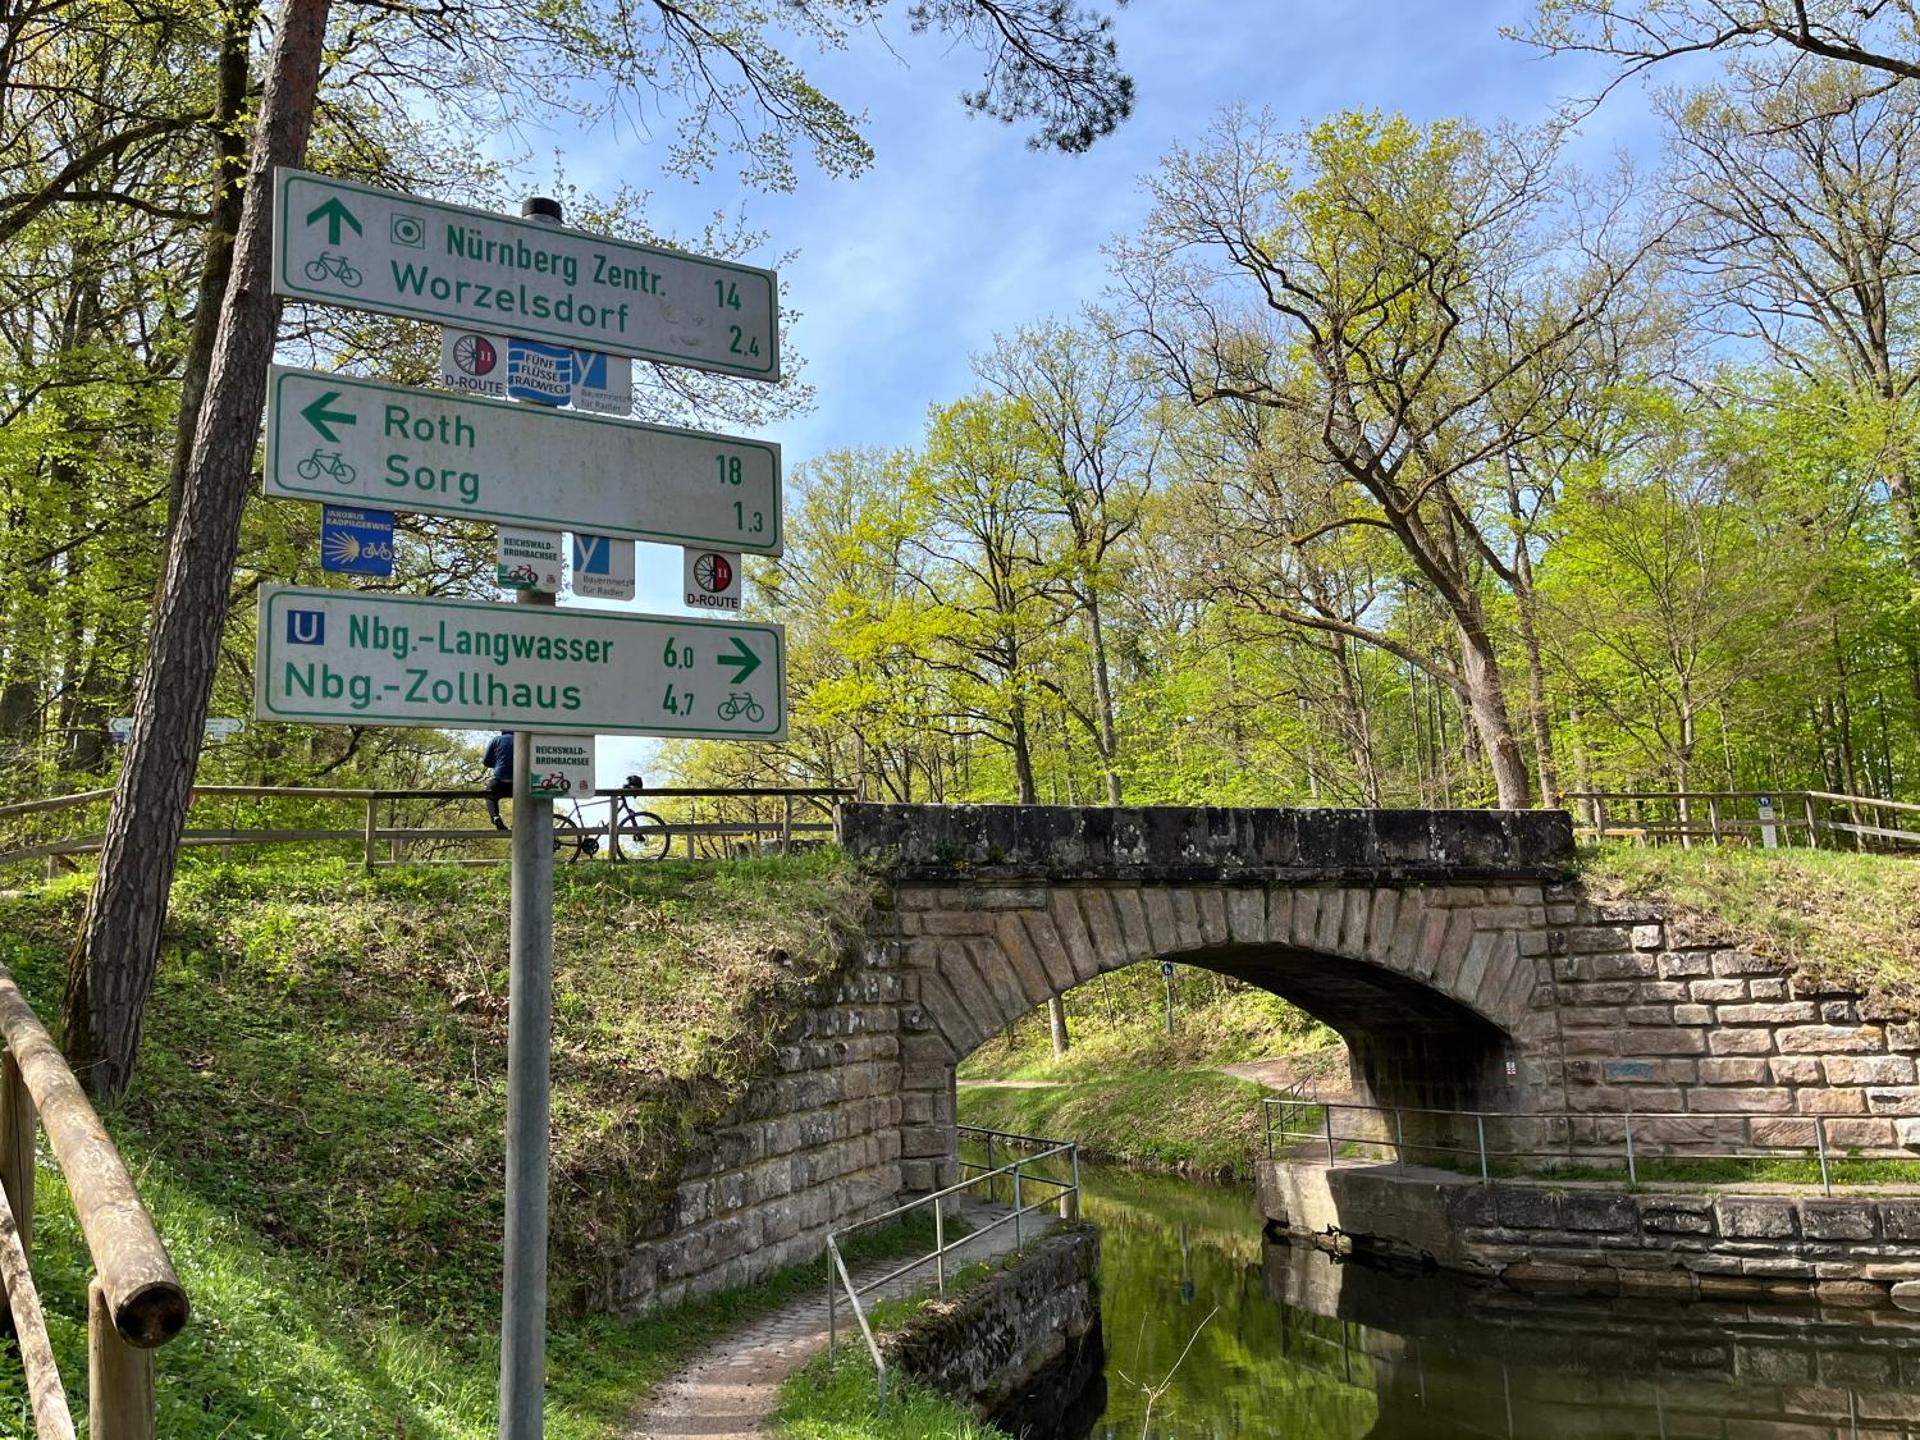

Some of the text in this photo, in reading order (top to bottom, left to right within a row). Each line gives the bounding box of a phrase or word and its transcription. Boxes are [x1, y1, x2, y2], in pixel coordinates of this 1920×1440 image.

[447, 223, 742, 311] Nürnberg Zentr. 14
[391, 260, 629, 333] Worzelsdorf
[525, 353, 555, 369] FÜNF
[521, 364, 560, 382] FLÜSSE
[445, 374, 504, 394] D-ROUTE
[515, 374, 565, 394] RADWEG
[384, 404, 742, 487] Roth 18
[384, 454, 480, 504] Sorg
[504, 537, 555, 550] REICHSWALD-
[504, 547, 558, 561] BROMBACHSEE
[687, 593, 739, 609] D-ROUTE
[294, 613, 318, 643] U
[348, 614, 614, 666] Nbg.-Langwasser
[285, 662, 582, 711] Nbg.-Zollhaus
[535, 745, 587, 755] REICHSWALD-
[535, 756, 590, 766] BROMBACHSEE
